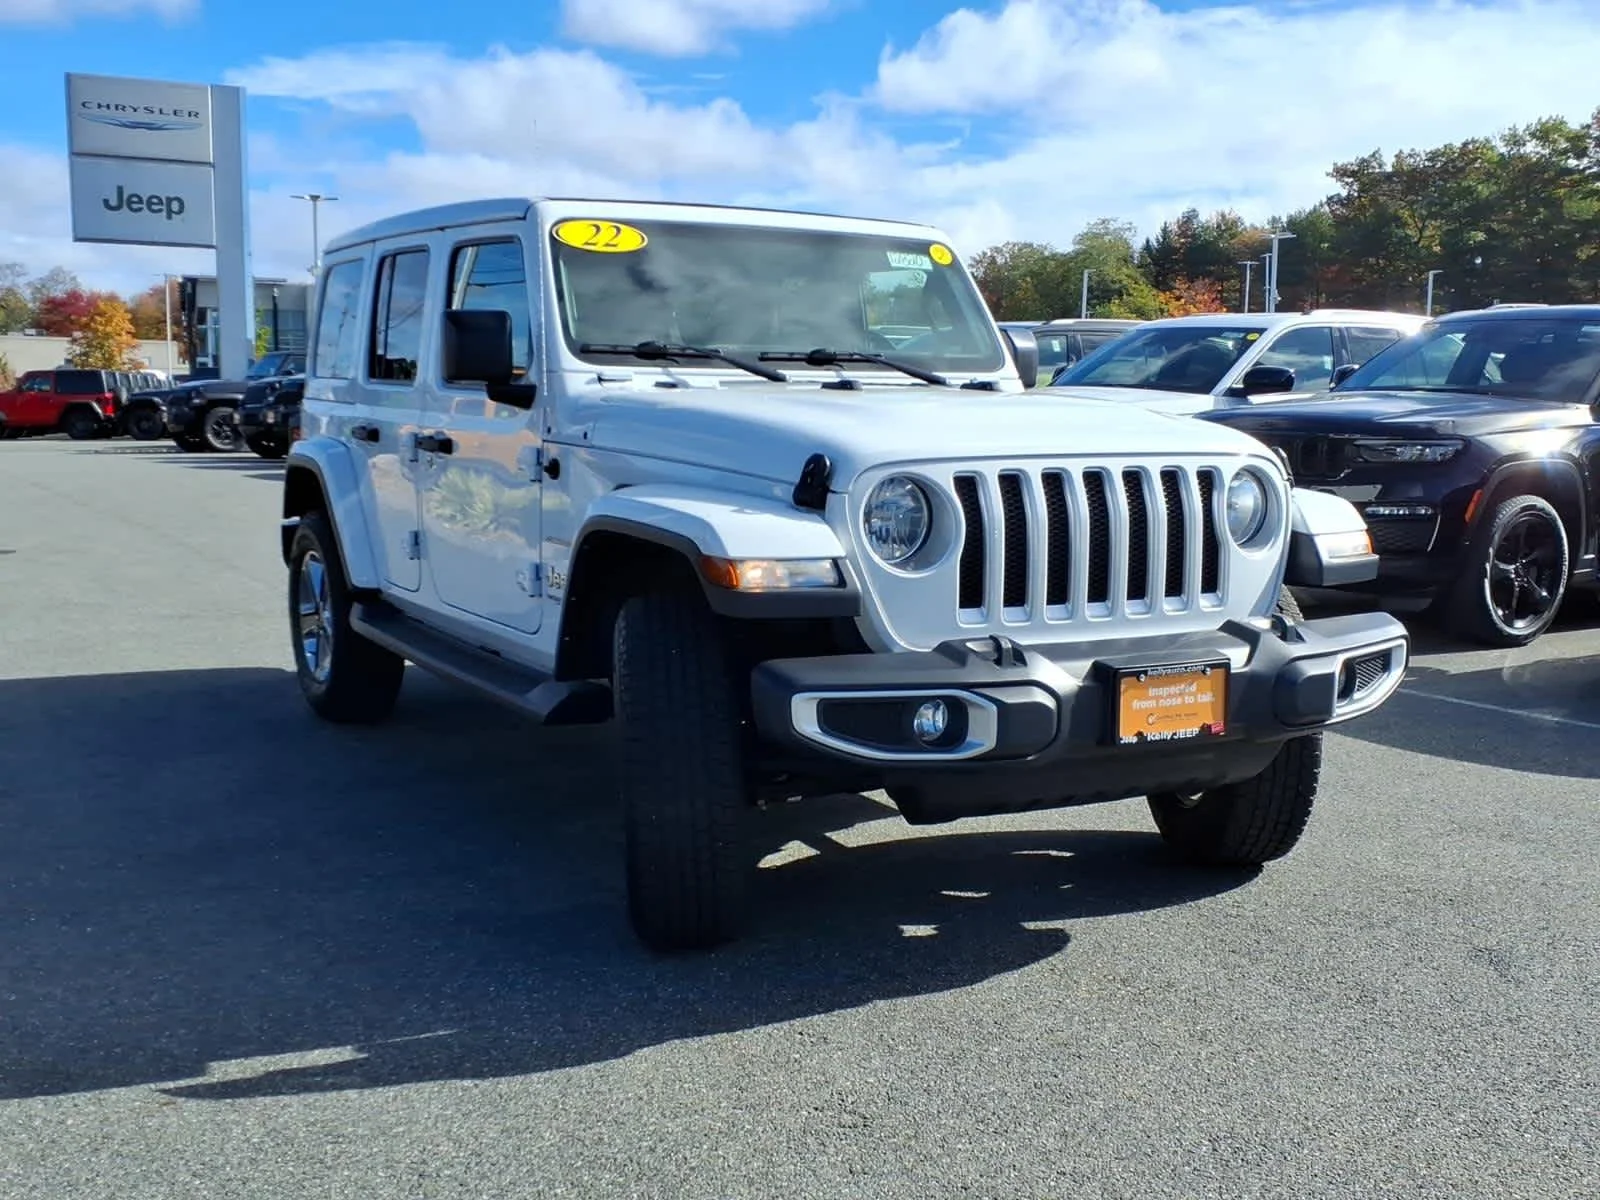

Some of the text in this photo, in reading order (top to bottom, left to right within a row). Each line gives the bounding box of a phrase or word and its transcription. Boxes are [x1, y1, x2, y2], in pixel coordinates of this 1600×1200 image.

[81, 101, 200, 118] CHRYSLER
[102, 185, 185, 220] Jeep
[581, 223, 622, 247] 22
[1132, 699, 1157, 711] from
[1159, 696, 1183, 708] nose
[1184, 694, 1195, 704] to
[1147, 730, 1173, 741] Kelly
[1173, 727, 1200, 740] JEEP
